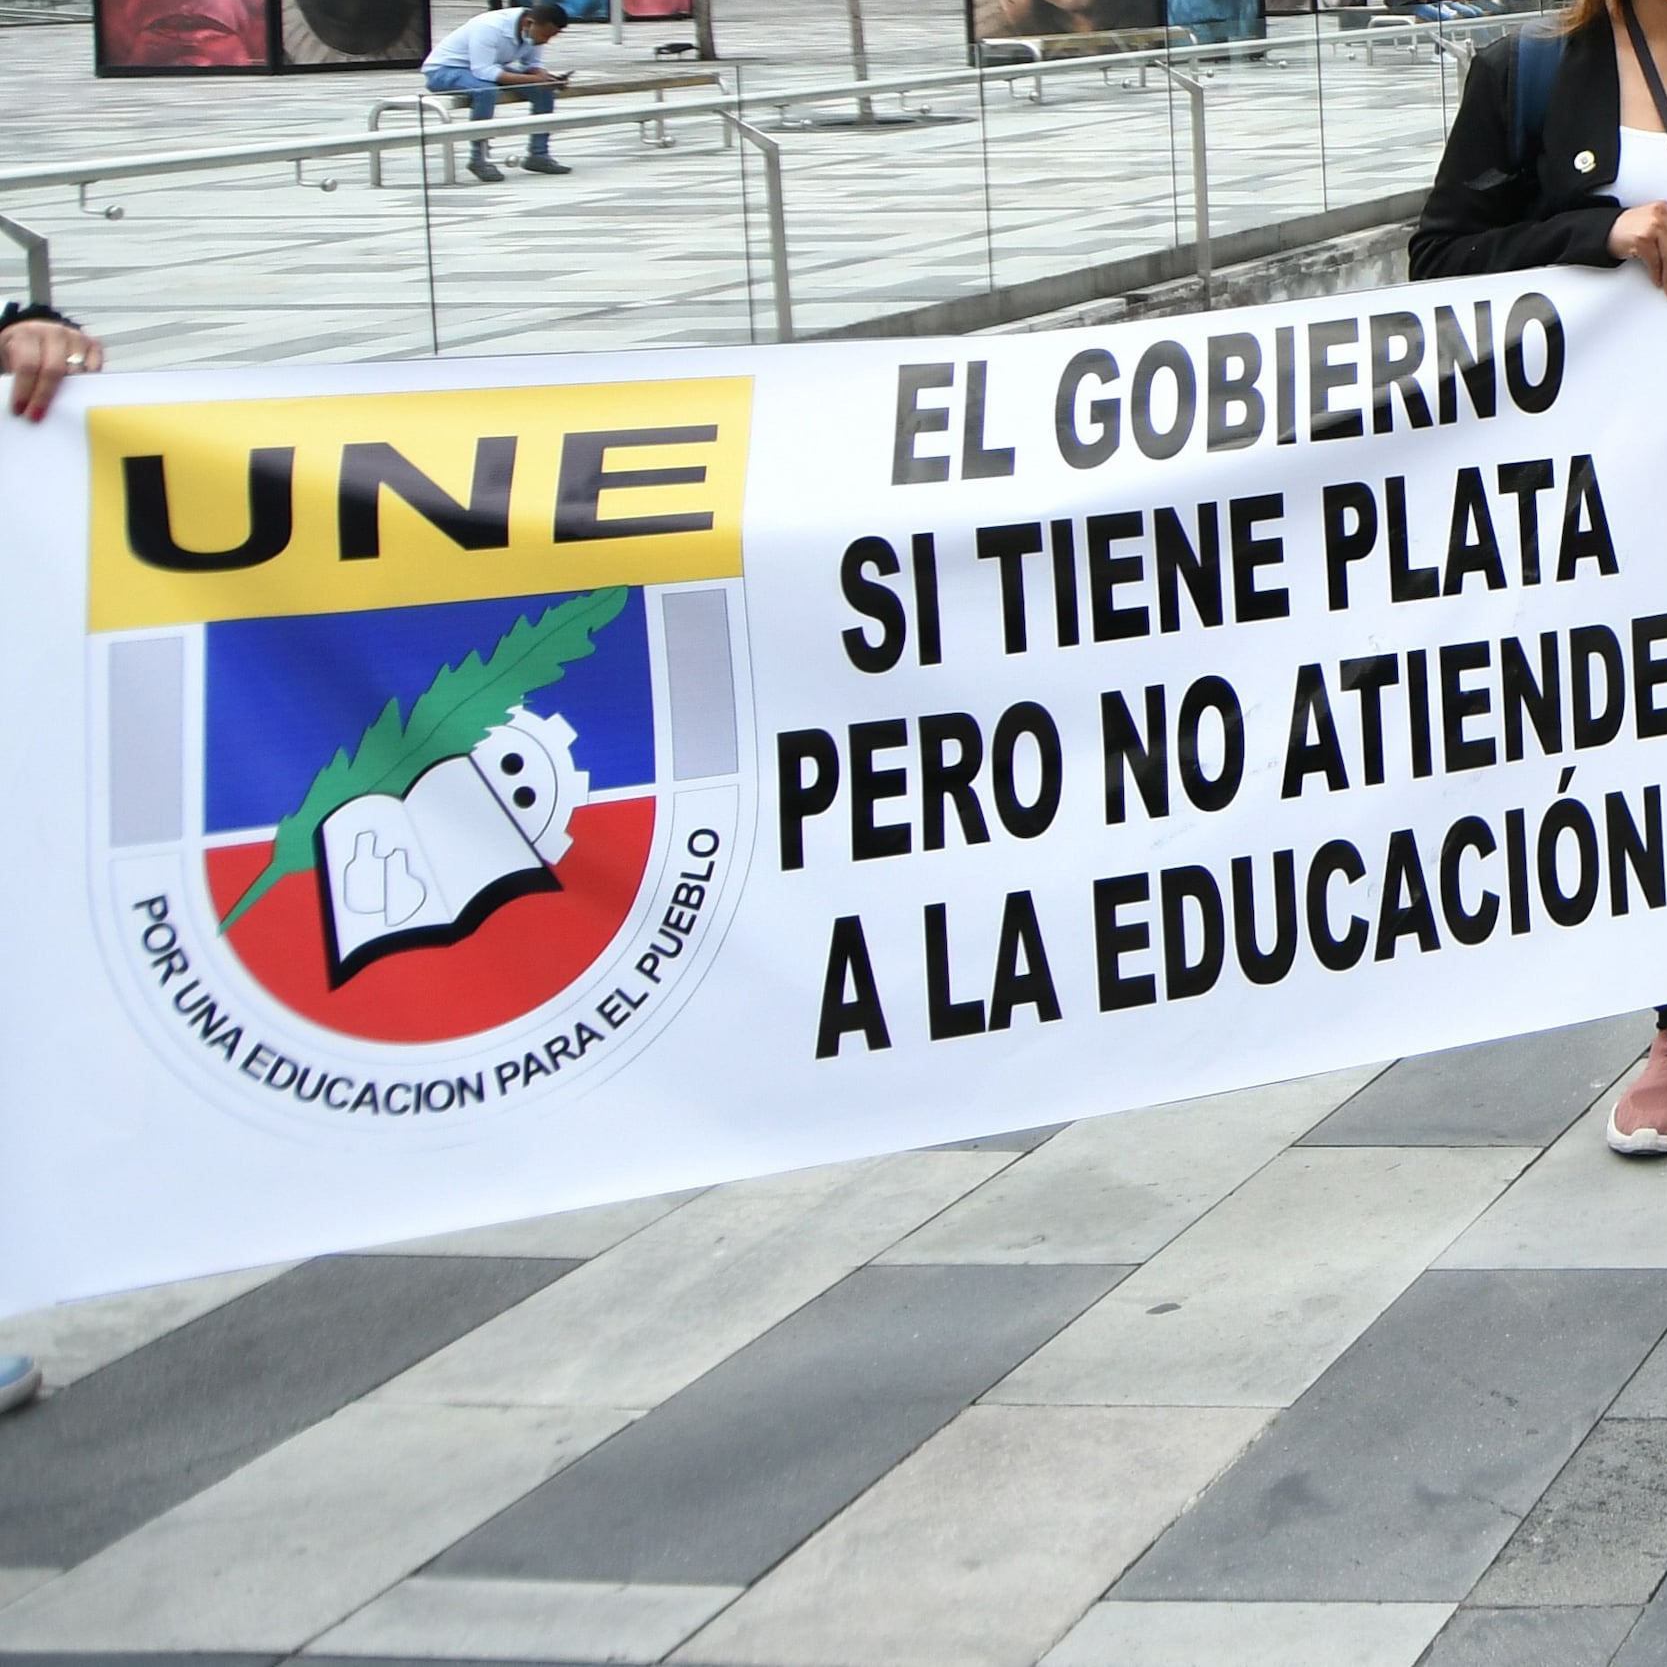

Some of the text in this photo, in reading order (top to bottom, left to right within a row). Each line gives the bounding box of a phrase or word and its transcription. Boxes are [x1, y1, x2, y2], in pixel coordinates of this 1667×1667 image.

[891, 291, 1566, 487] EL GOBIERNO
[121, 424, 720, 574] UNE
[839, 453, 1620, 674] SI TIENE PLATA
[777, 699, 1063, 872] PERO
[1101, 674, 1246, 825] NO
[133, 826, 722, 1118] POR UNA EDUCACION PARA EL PUEBLO
[814, 766, 1667, 1061] A LA EDUCACIÓN
